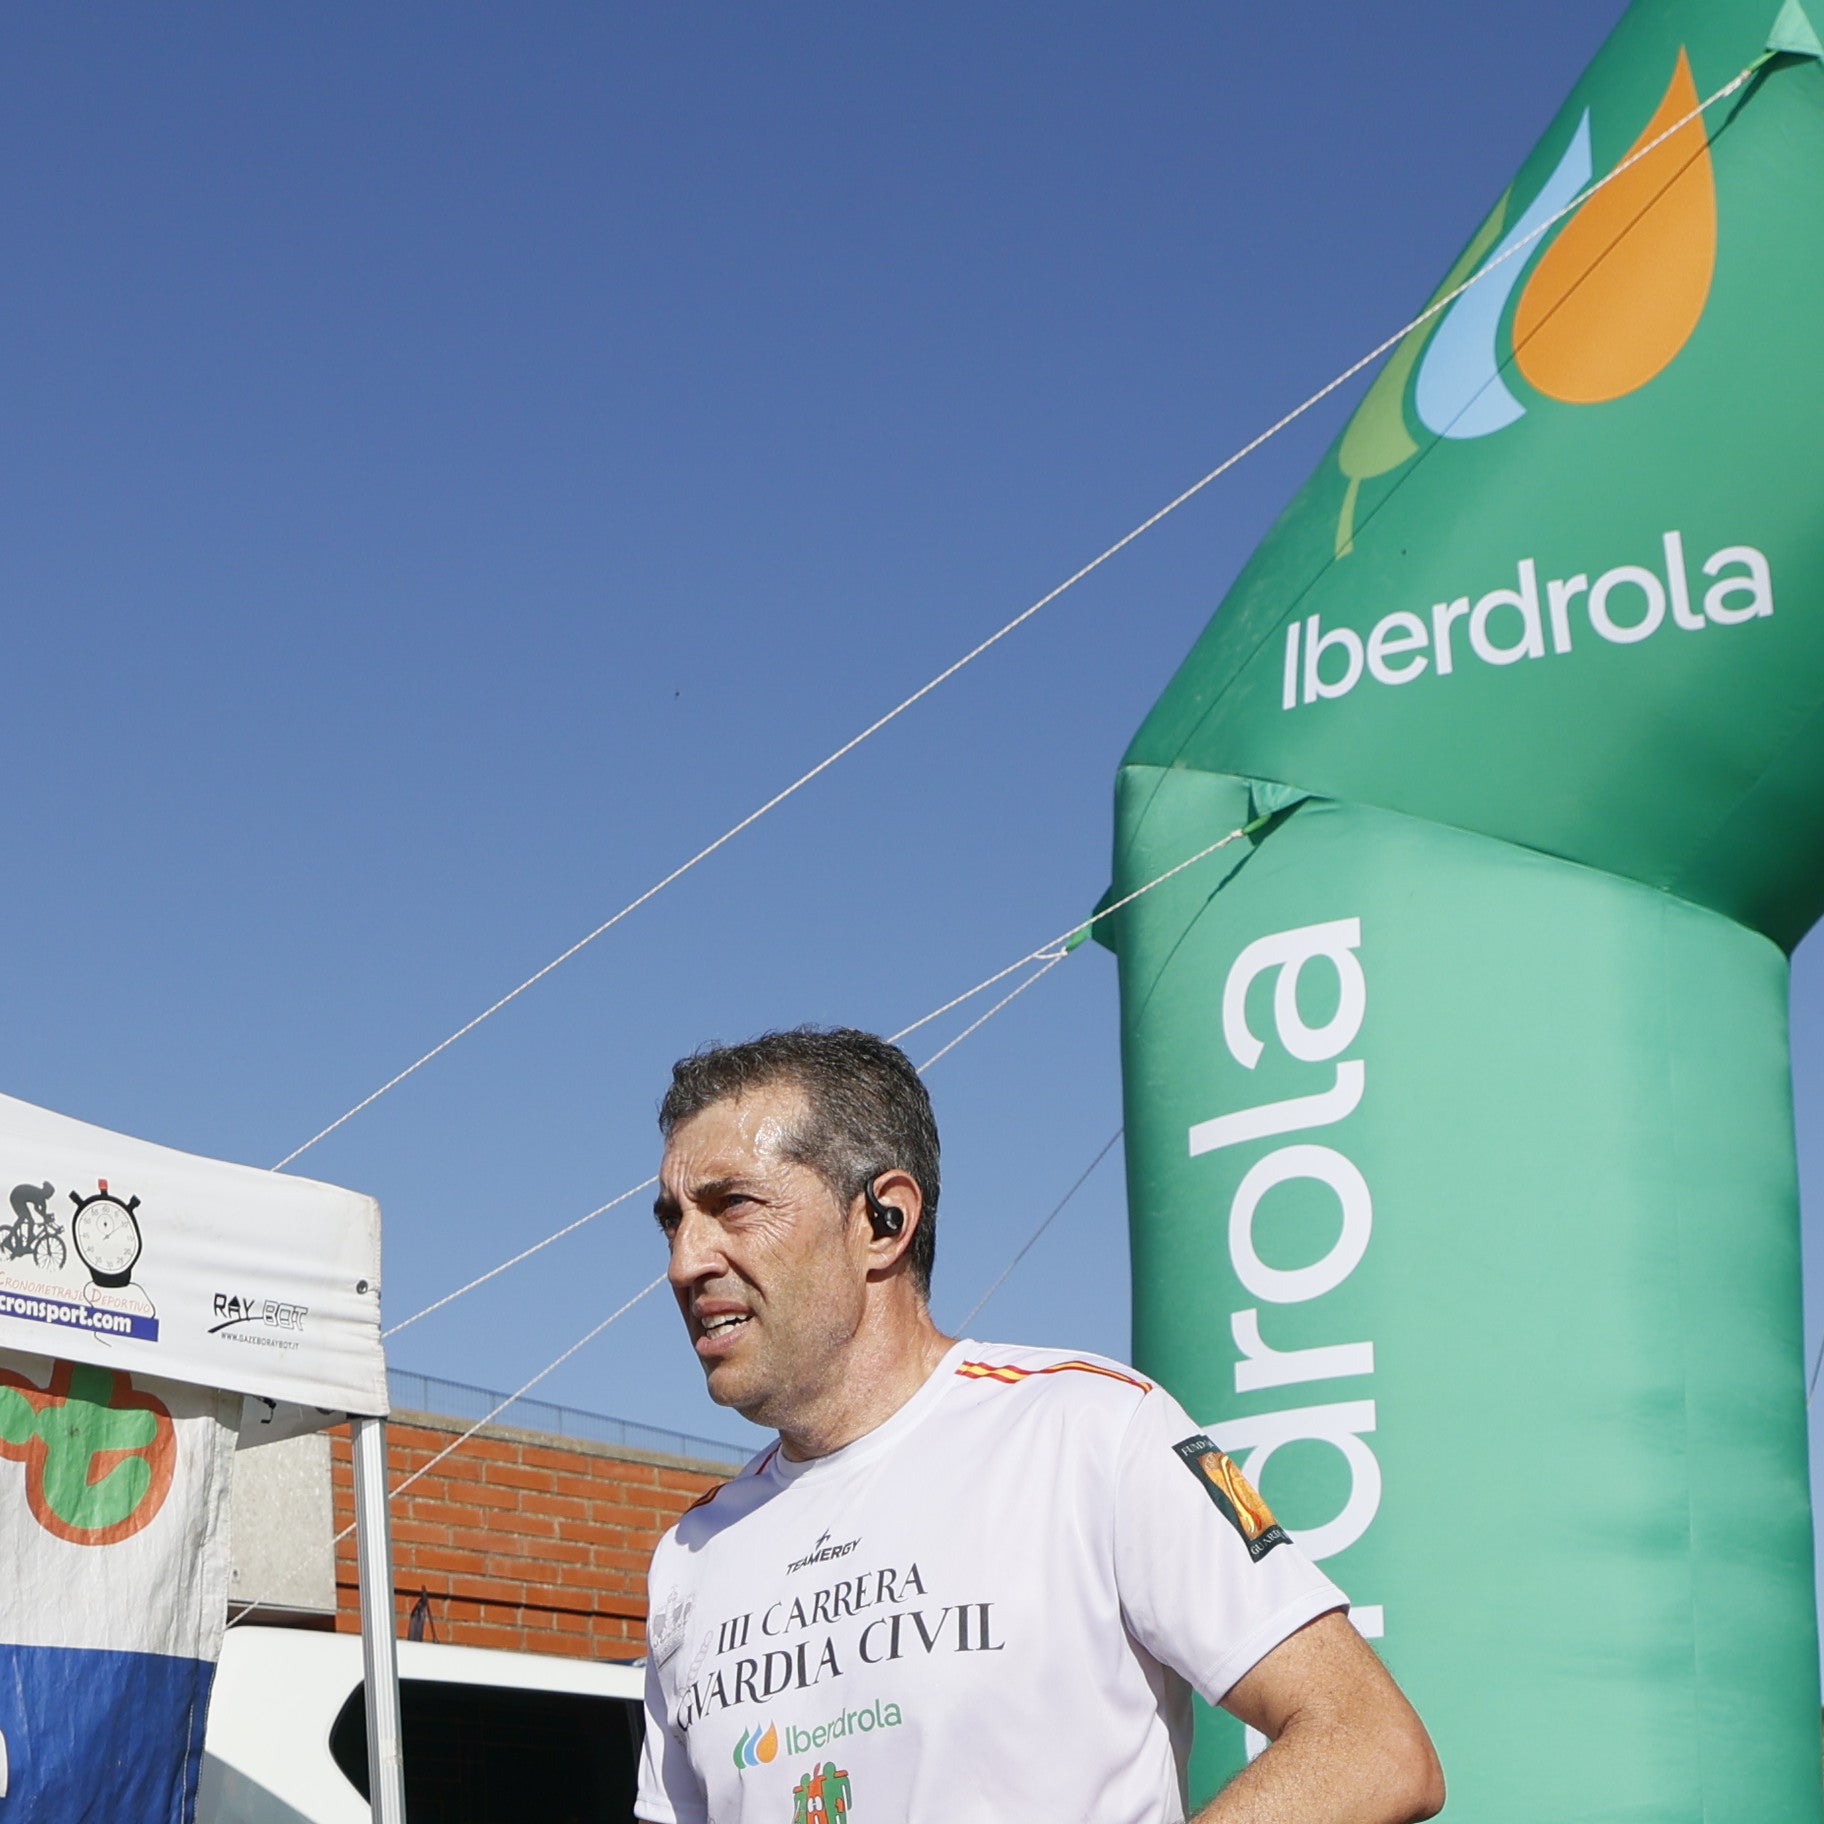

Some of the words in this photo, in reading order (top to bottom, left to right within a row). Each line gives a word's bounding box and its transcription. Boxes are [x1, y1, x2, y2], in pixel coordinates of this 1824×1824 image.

[1281, 531, 1774, 710] Iberdrola
[91, 1287, 152, 1315] DEPORTIVO
[213, 1292, 256, 1321] RAY
[785, 1535, 863, 1576] TEAMERGY
[715, 1611, 754, 1657] III
[761, 1562, 928, 1637] CARRERA
[676, 1637, 845, 1733] GVARDIA
[858, 1602, 1006, 1664] CIVIL
[785, 1697, 904, 1757] Iberdrola
